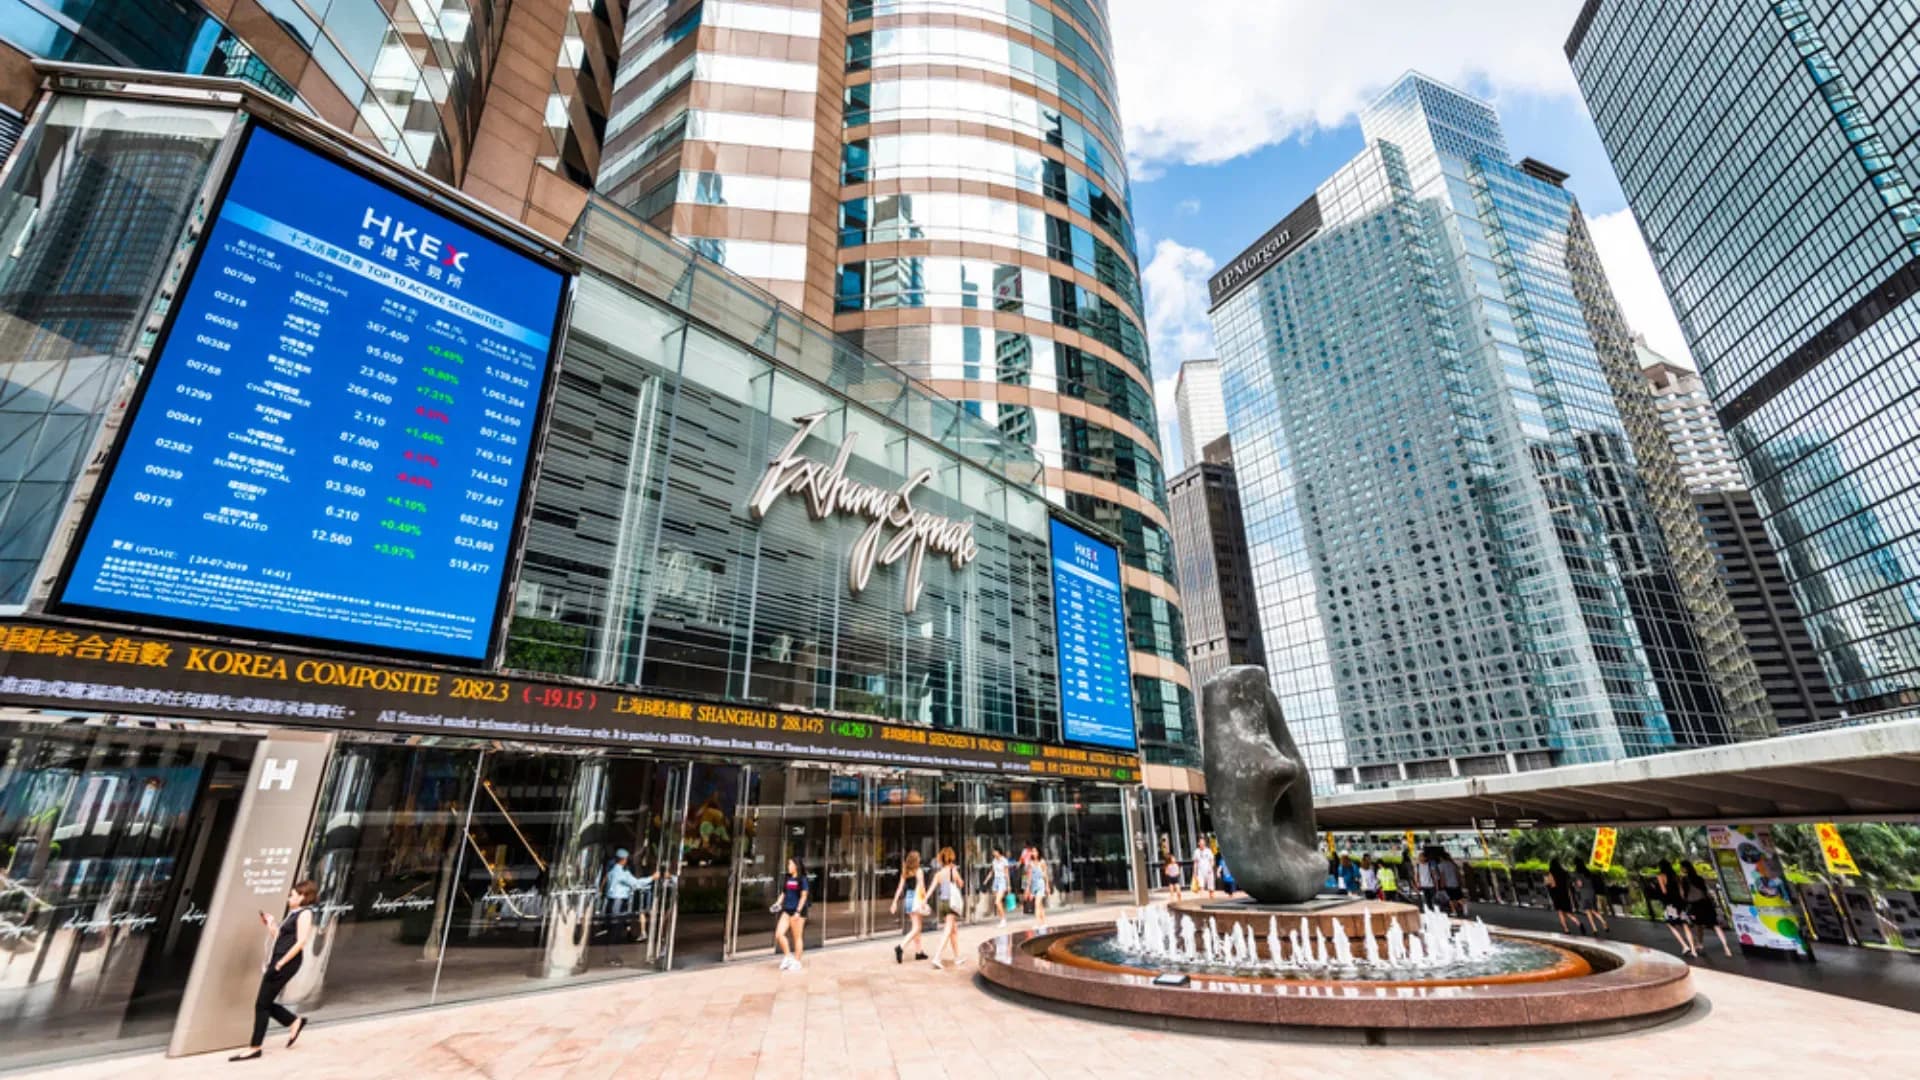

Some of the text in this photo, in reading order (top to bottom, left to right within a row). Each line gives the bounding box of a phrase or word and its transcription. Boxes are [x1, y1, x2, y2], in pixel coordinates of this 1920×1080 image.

[363, 208, 468, 272] HKEX
[368, 266, 391, 279] TOP
[394, 277, 406, 287] 10
[408, 284, 445, 304] ACTIVE
[449, 300, 506, 330] SECURITIES
[354, 411, 386, 426] 2.110
[251, 467, 290, 482] OPTICAL
[134, 492, 172, 507] 00175
[203, 513, 268, 531] GEELY AUTO
[326, 506, 359, 521] 6.210
[0, 626, 173, 668] 國綜合指數
[184, 647, 288, 680] KOREA
[295, 661, 440, 695] COMPOSITE
[449, 678, 510, 702] 2082.3
[377, 709, 397, 723] All
[398, 711, 443, 726] financial
[443, 716, 477, 729] market
[478, 718, 530, 733] information
[532, 722, 541, 733] is
[555, 725, 591, 737] reference
[628, 730, 659, 743] provided
[697, 705, 766, 729] SHANGHAI
[768, 714, 777, 729] B
